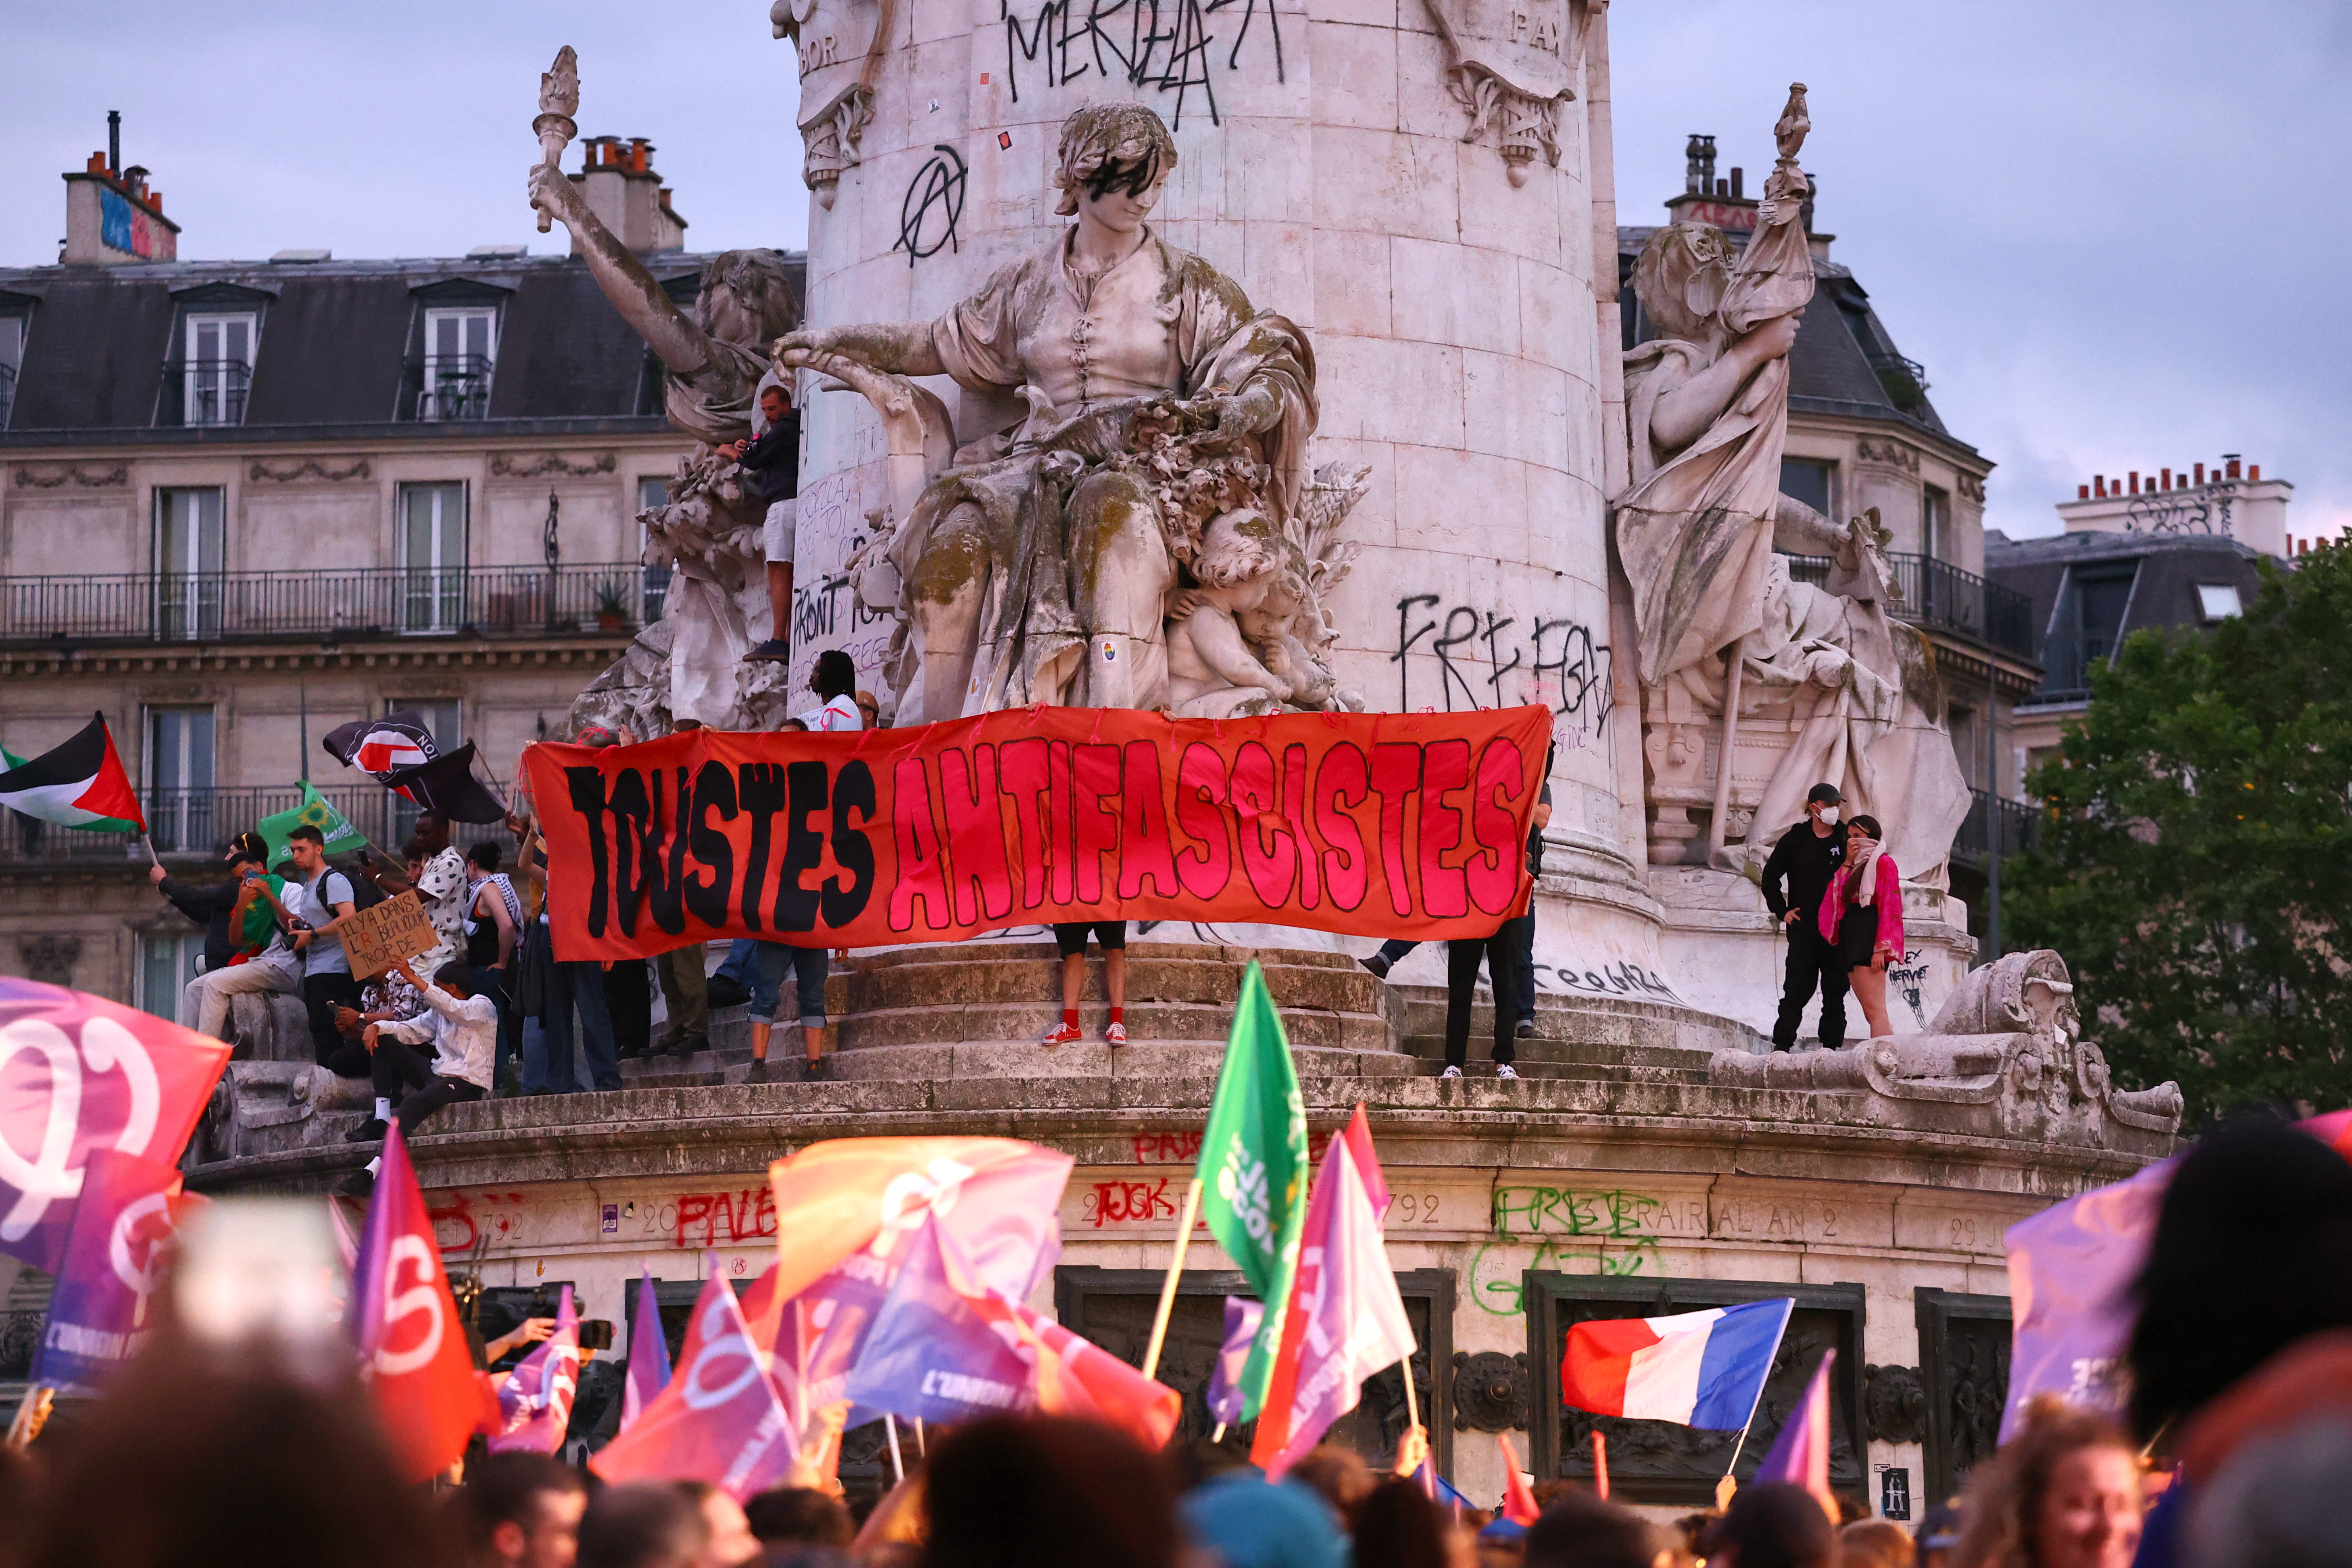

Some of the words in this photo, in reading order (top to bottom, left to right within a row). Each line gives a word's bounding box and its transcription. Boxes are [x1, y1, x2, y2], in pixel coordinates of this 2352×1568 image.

[793, 576, 849, 661] FRONT
[564, 760, 876, 939] TOUSTES
[887, 736, 1524, 932] ANTIFASCISTES
[340, 920, 359, 938] IL
[357, 914, 365, 930] Y
[367, 911, 377, 925] A
[379, 895, 415, 921] DANS
[377, 910, 425, 942] BEAUCOUP
[359, 944, 393, 970] TROP
[396, 935, 416, 955] DE
[415, 927, 433, 948] N
[643, 1203, 678, 1233] 20
[1383, 1193, 1440, 1224] 792
[1766, 1207, 1805, 1235] AN
[1821, 1209, 1837, 1237] 2
[1951, 1217, 1977, 1247] 29
